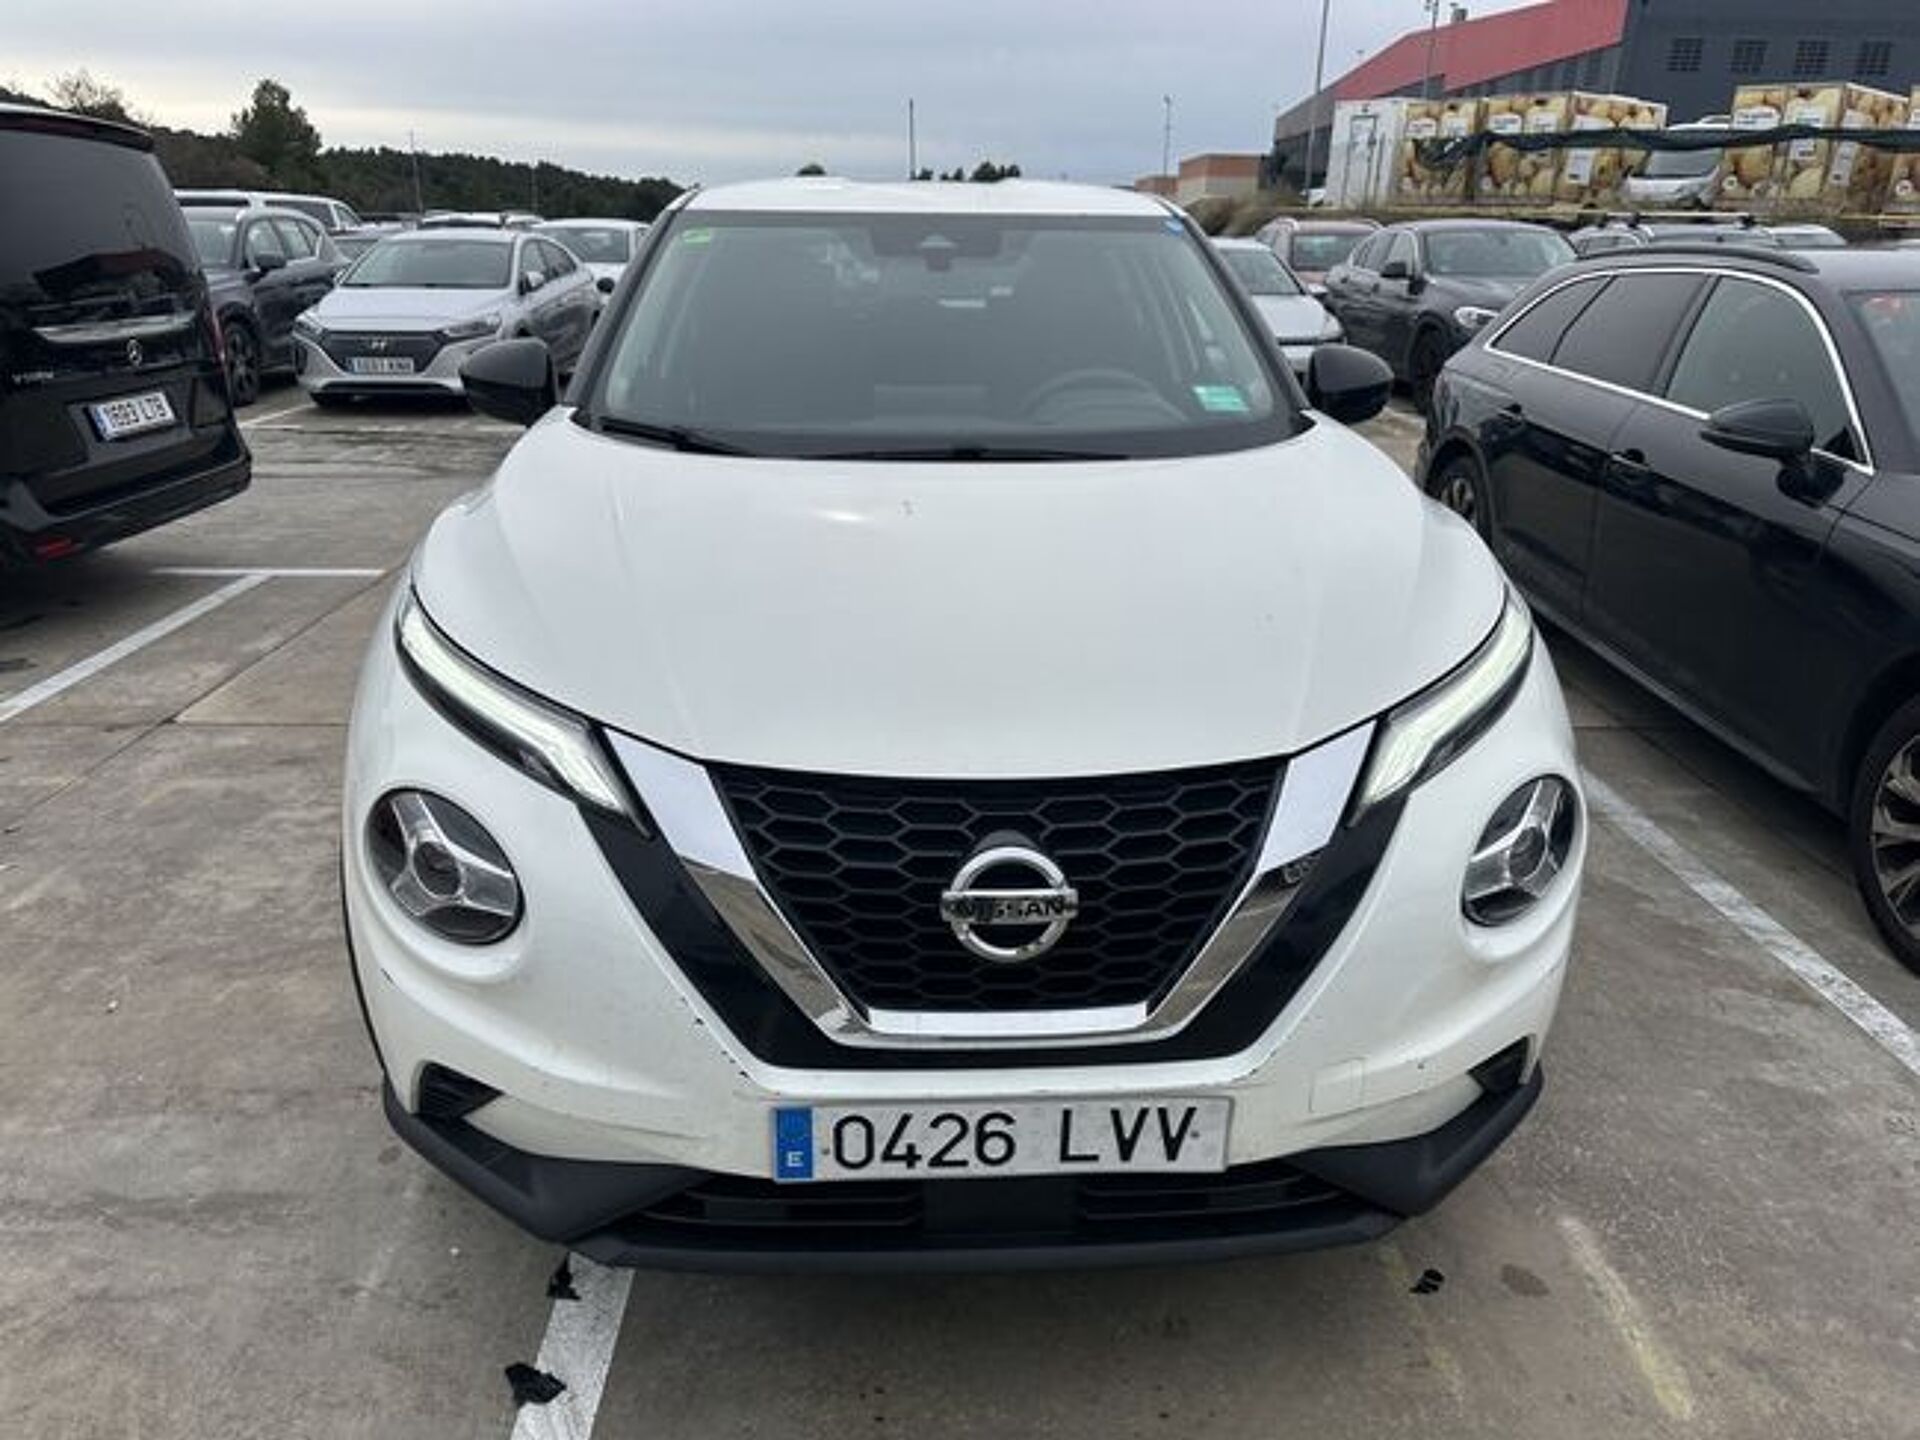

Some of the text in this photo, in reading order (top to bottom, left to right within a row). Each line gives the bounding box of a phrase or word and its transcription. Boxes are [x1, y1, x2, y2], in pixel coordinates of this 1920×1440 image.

[787, 1106, 1197, 1170] E 0426 LVV
